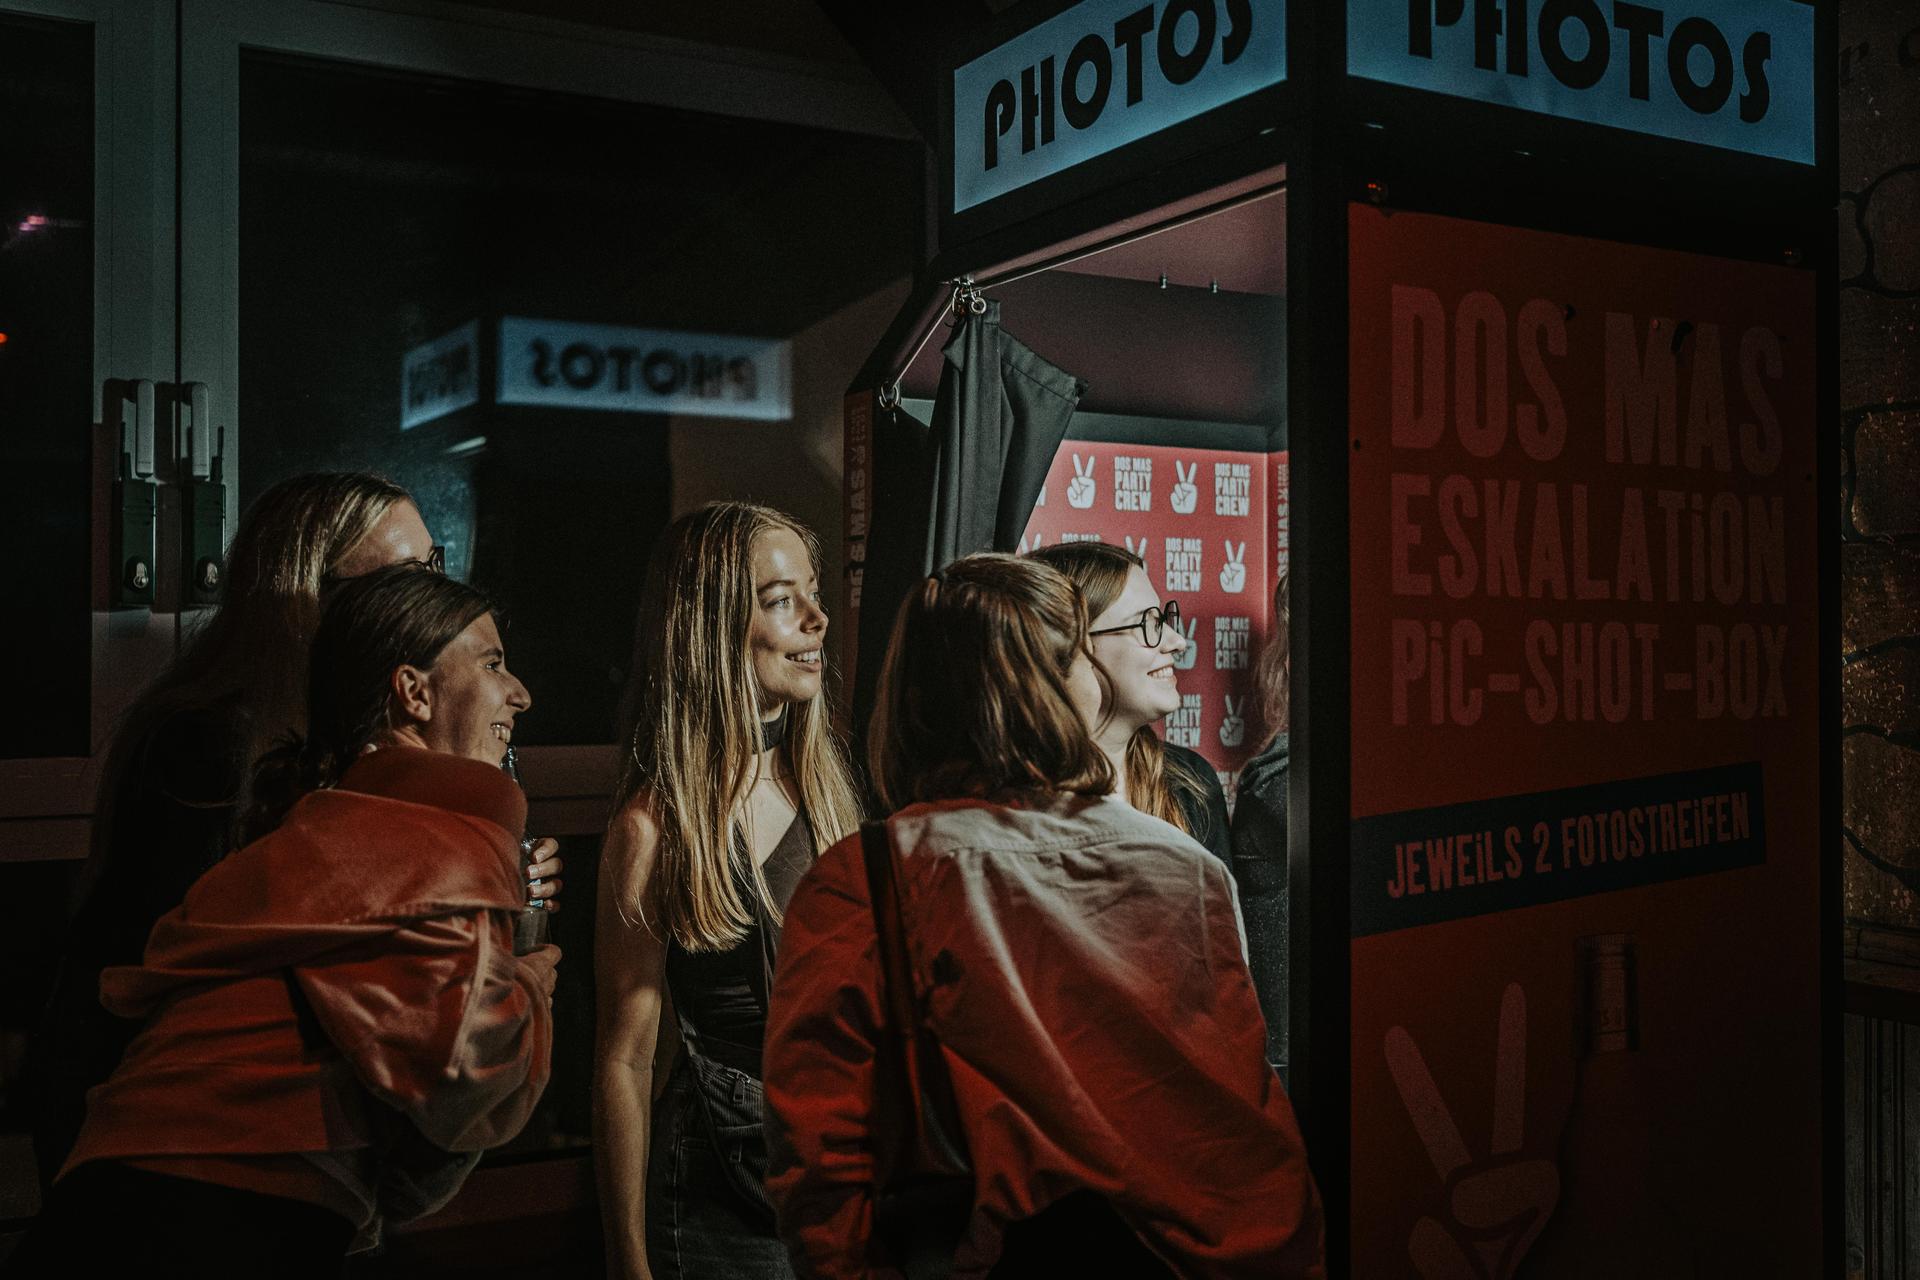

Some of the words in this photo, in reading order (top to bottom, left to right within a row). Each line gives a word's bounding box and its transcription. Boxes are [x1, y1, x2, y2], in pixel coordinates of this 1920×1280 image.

[1409, 0, 1771, 123] PHOTOS
[985, 0, 1252, 170] PHOTOS
[1391, 283, 1568, 462] DOS
[1604, 312, 1784, 479] MAS
[1114, 471, 1152, 491] PARTY
[1215, 476, 1250, 497] PARTY
[1114, 490, 1151, 512] CREW
[1215, 496, 1250, 517] CREW
[1166, 551, 1202, 572] PARTY
[1166, 571, 1201, 592] CREW
[1215, 630, 1249, 650] PARTY
[1215, 649, 1249, 670] CREW
[1165, 727, 1201, 748] CREW
[1533, 821, 1552, 875] 2
